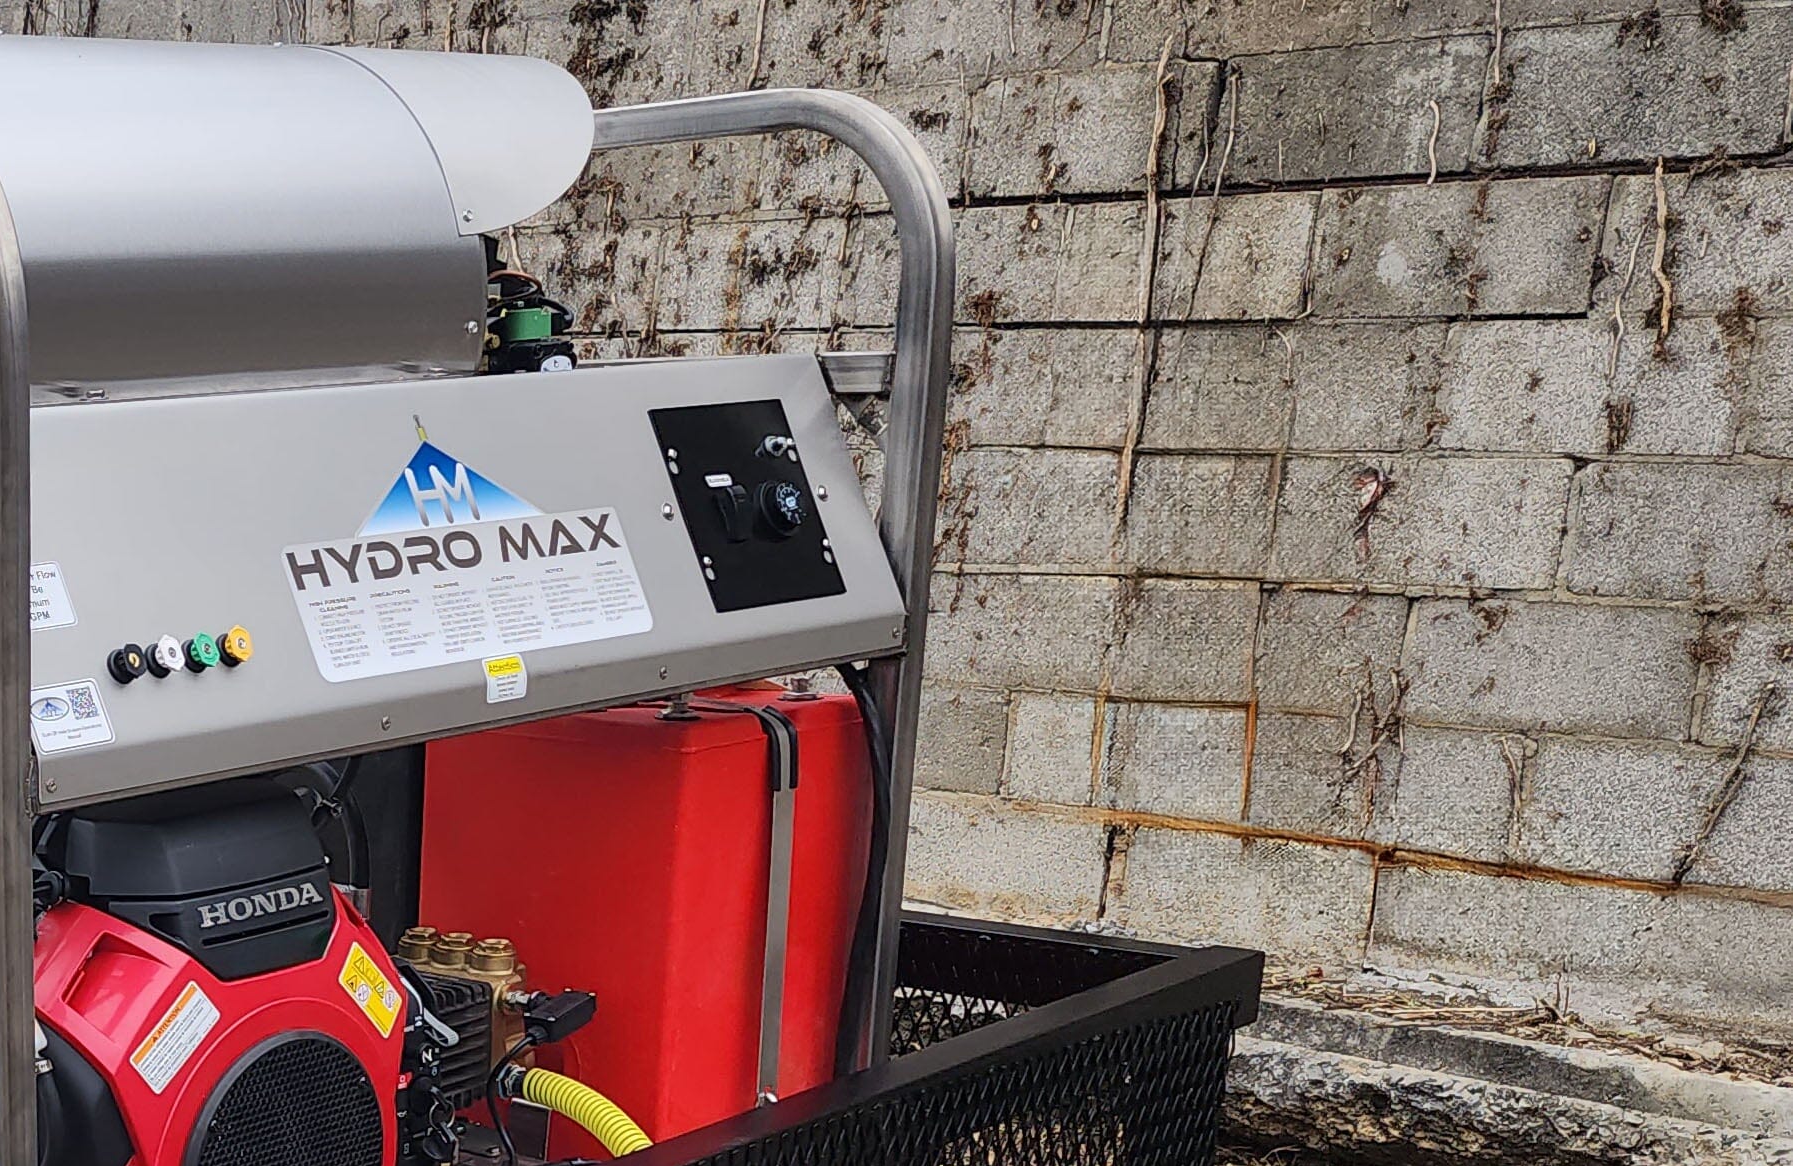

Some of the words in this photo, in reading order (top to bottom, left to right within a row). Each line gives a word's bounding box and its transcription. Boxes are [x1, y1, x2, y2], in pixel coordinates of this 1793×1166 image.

[405, 462, 481, 528] HM
[287, 530, 483, 592] HYDRO
[498, 512, 622, 563] MAX
[197, 882, 324, 928] HONDA
